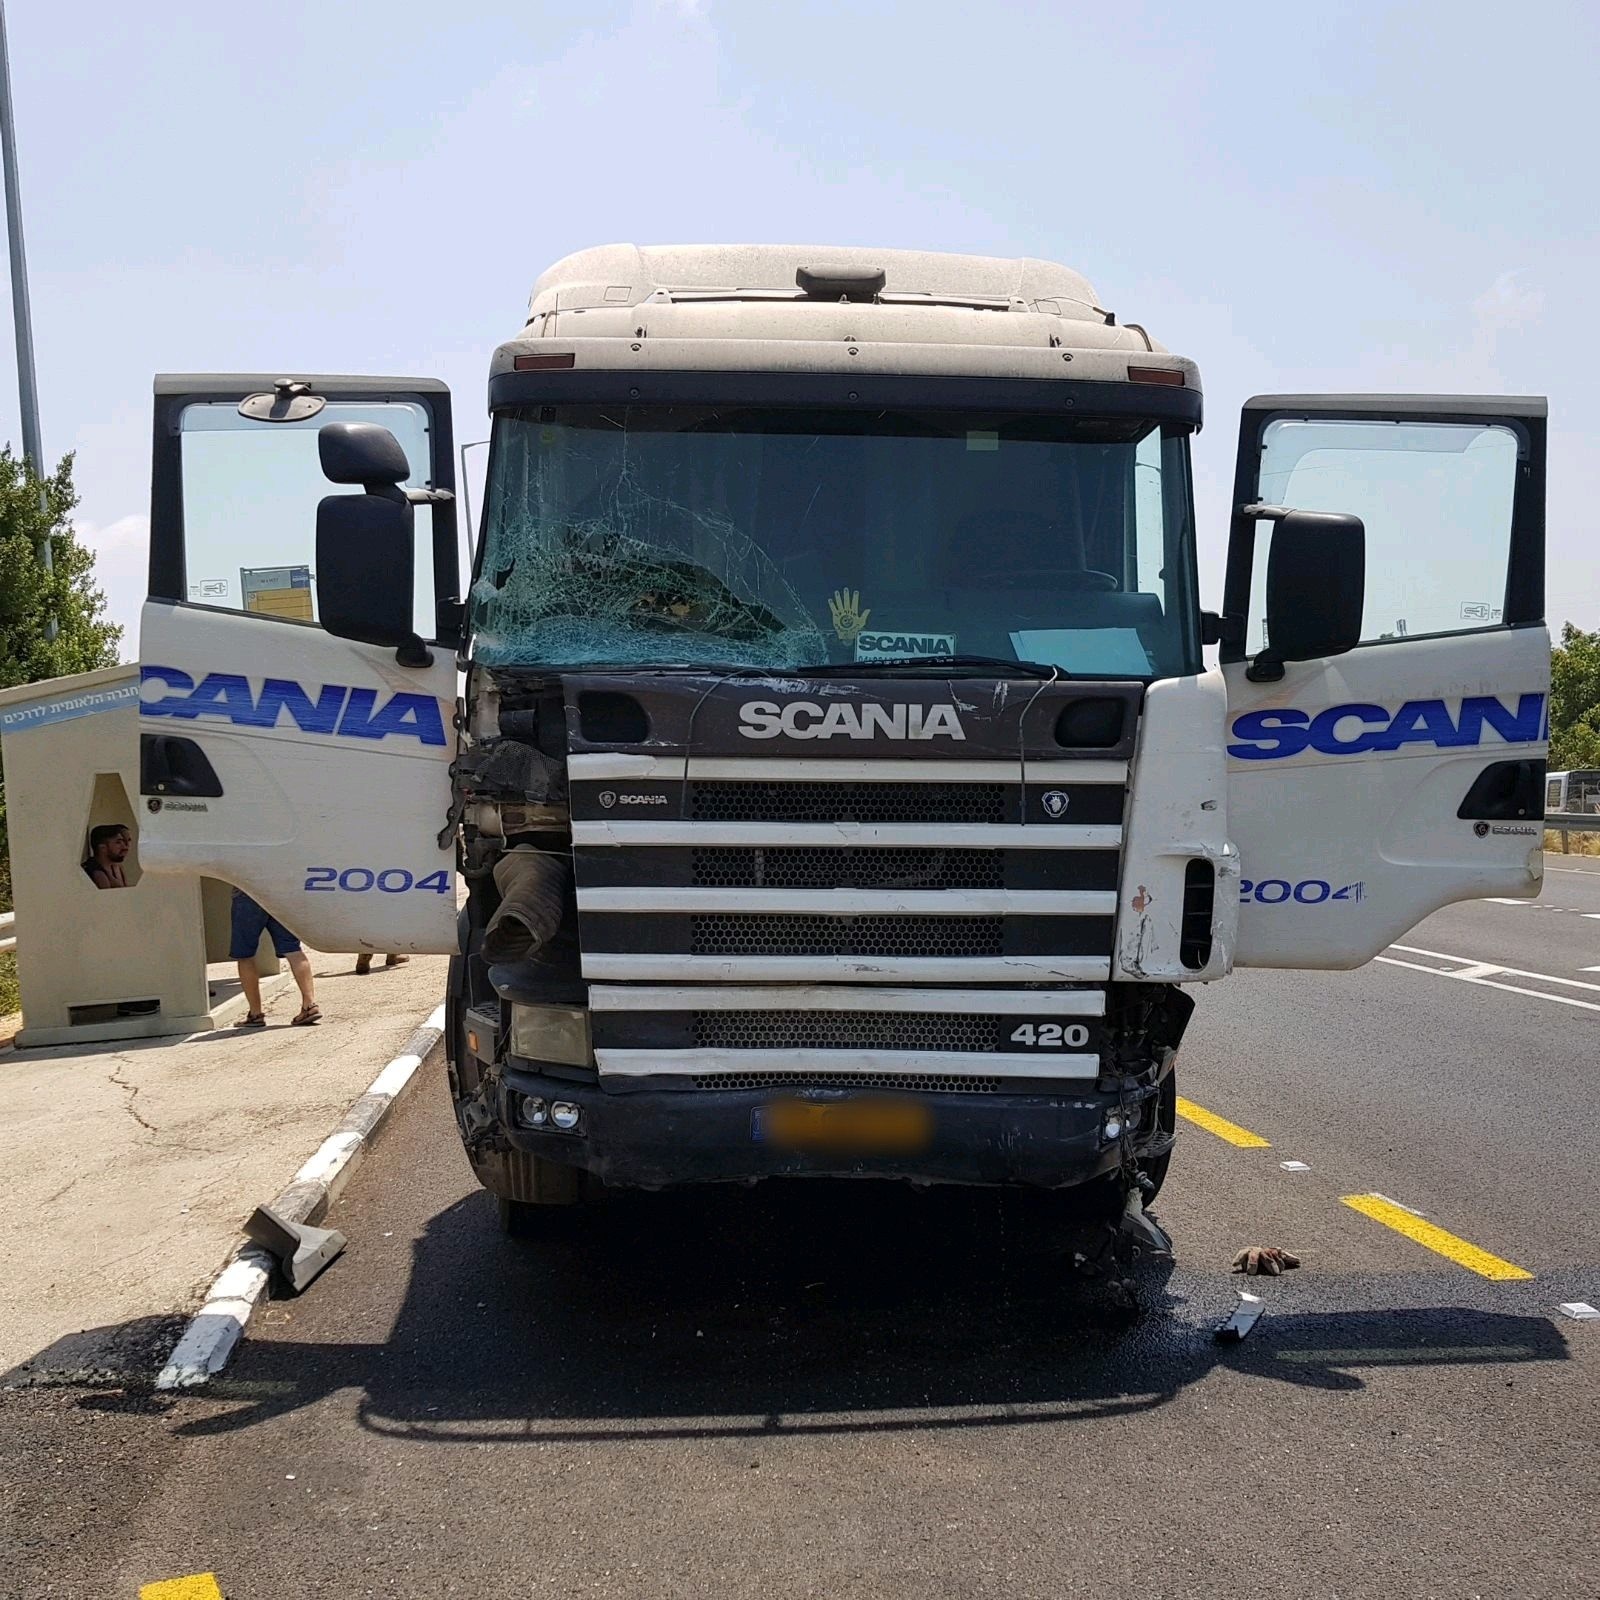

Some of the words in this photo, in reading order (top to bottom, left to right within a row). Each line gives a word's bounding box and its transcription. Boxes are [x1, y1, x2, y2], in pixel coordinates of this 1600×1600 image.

[859, 635, 952, 655] SCANIA
[50, 693, 104, 714] הלאומית
[106, 685, 140, 701] חברה
[4, 705, 46, 724] לדרכים
[139, 665, 447, 746] CANIA
[738, 701, 966, 740] SCANIA
[1227, 693, 1548, 760] SCAN
[619, 794, 668, 805] SCANIA
[304, 867, 450, 894] 2004
[1010, 1023, 1089, 1047] 420
